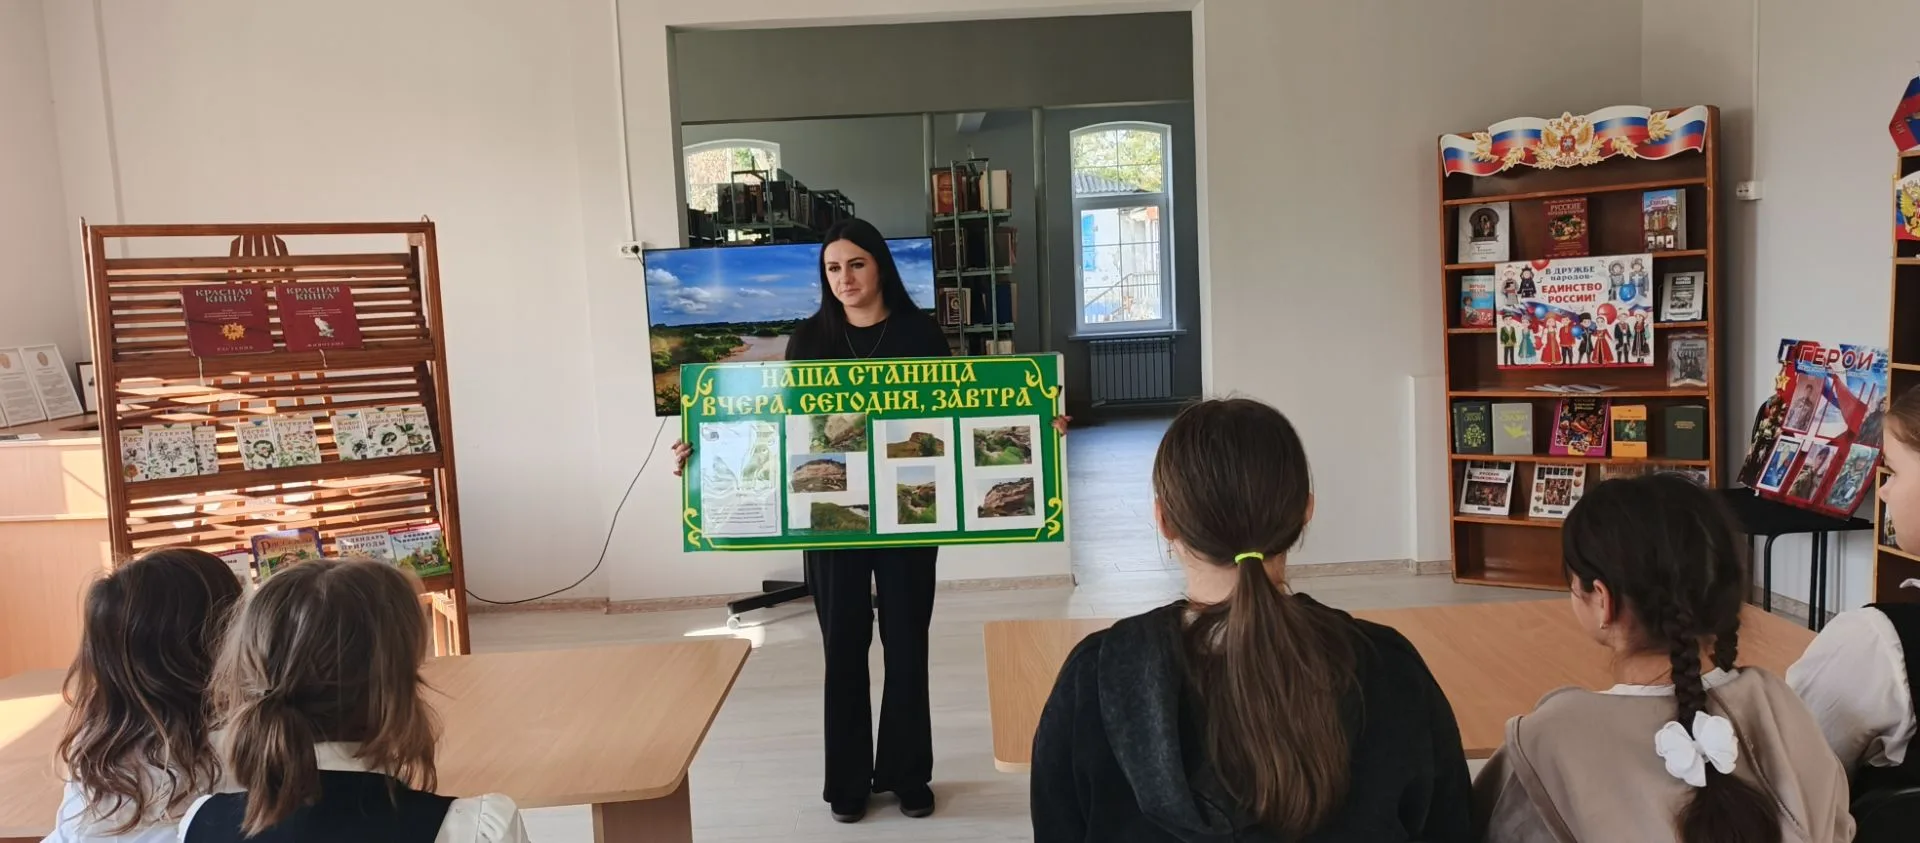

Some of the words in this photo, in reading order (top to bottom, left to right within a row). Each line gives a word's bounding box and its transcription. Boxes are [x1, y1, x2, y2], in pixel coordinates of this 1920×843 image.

[1553, 266, 1595, 275] ДРУЖБЕ
[195, 288, 253, 297] КРАСНАЯ
[286, 286, 341, 296] КРАСНАЯ
[1541, 282, 1603, 294] ЕДИНСТВО
[206, 294, 247, 303] КНИГА
[296, 293, 335, 302] КНИГА
[1548, 294, 1596, 303] РОССИИ!
[1798, 345, 1874, 372] ГЕРОИ
[762, 364, 842, 389] НАША
[848, 361, 976, 389] СТАНИЦА
[701, 393, 793, 416] ВЧЕРА,
[799, 390, 925, 414] СЕГОДНЯ,
[931, 387, 1033, 412] ЗАВТРА
